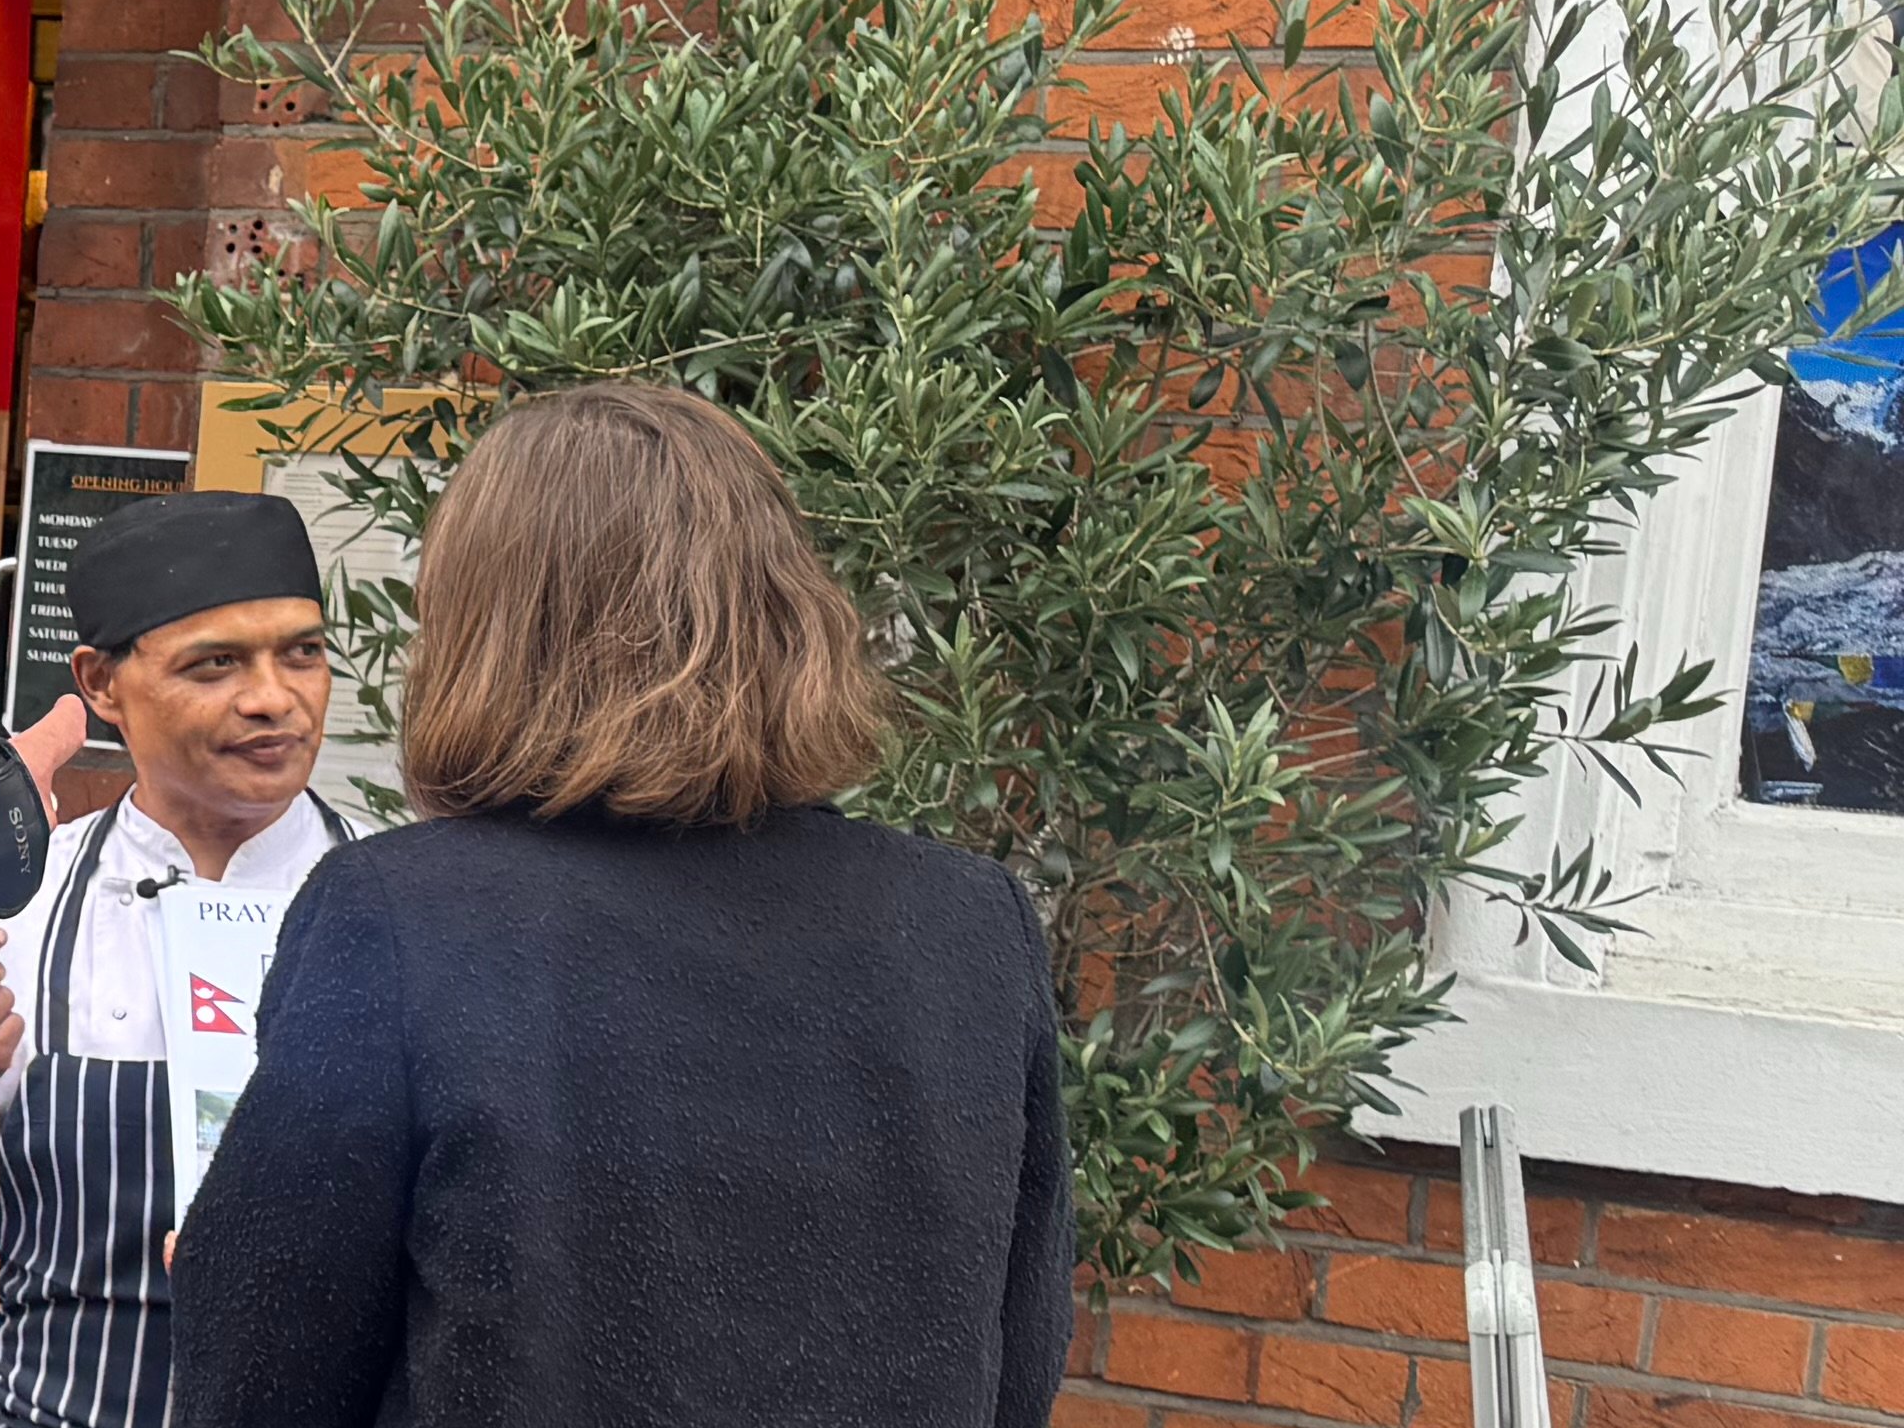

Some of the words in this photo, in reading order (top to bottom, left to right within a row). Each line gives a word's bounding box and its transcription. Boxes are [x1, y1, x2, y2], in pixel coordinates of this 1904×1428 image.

[71, 475, 141, 492] OPENING
[37, 535, 79, 550] TUESD
[28, 626, 81, 642] SATURD
[26, 649, 71, 665] SUNDA
[8, 806, 31, 874] SONY
[198, 901, 272, 924] PRAY
